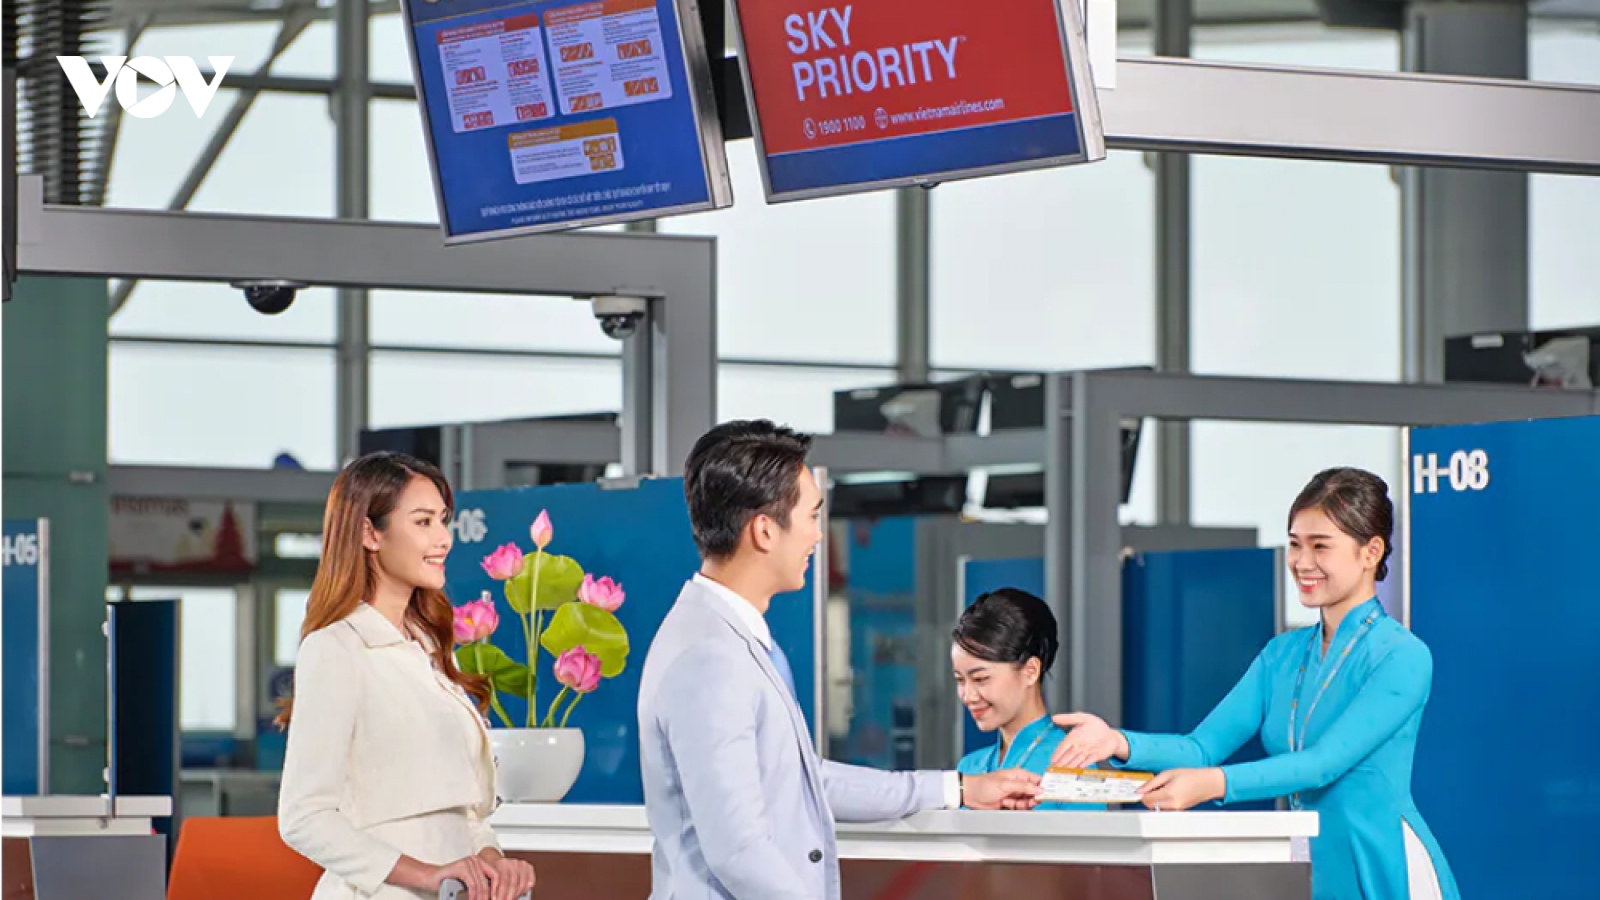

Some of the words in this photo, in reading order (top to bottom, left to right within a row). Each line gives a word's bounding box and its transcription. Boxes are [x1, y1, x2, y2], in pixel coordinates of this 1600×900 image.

[785, 5, 852, 54] SKY
[792, 36, 958, 101] PRIORITY
[818, 121, 841, 135] 1900
[843, 115, 866, 130] 1100
[890, 98, 1005, 124] www.vietnamairlines.com
[1413, 449, 1489, 494] H-08
[449, 508, 487, 543] -06
